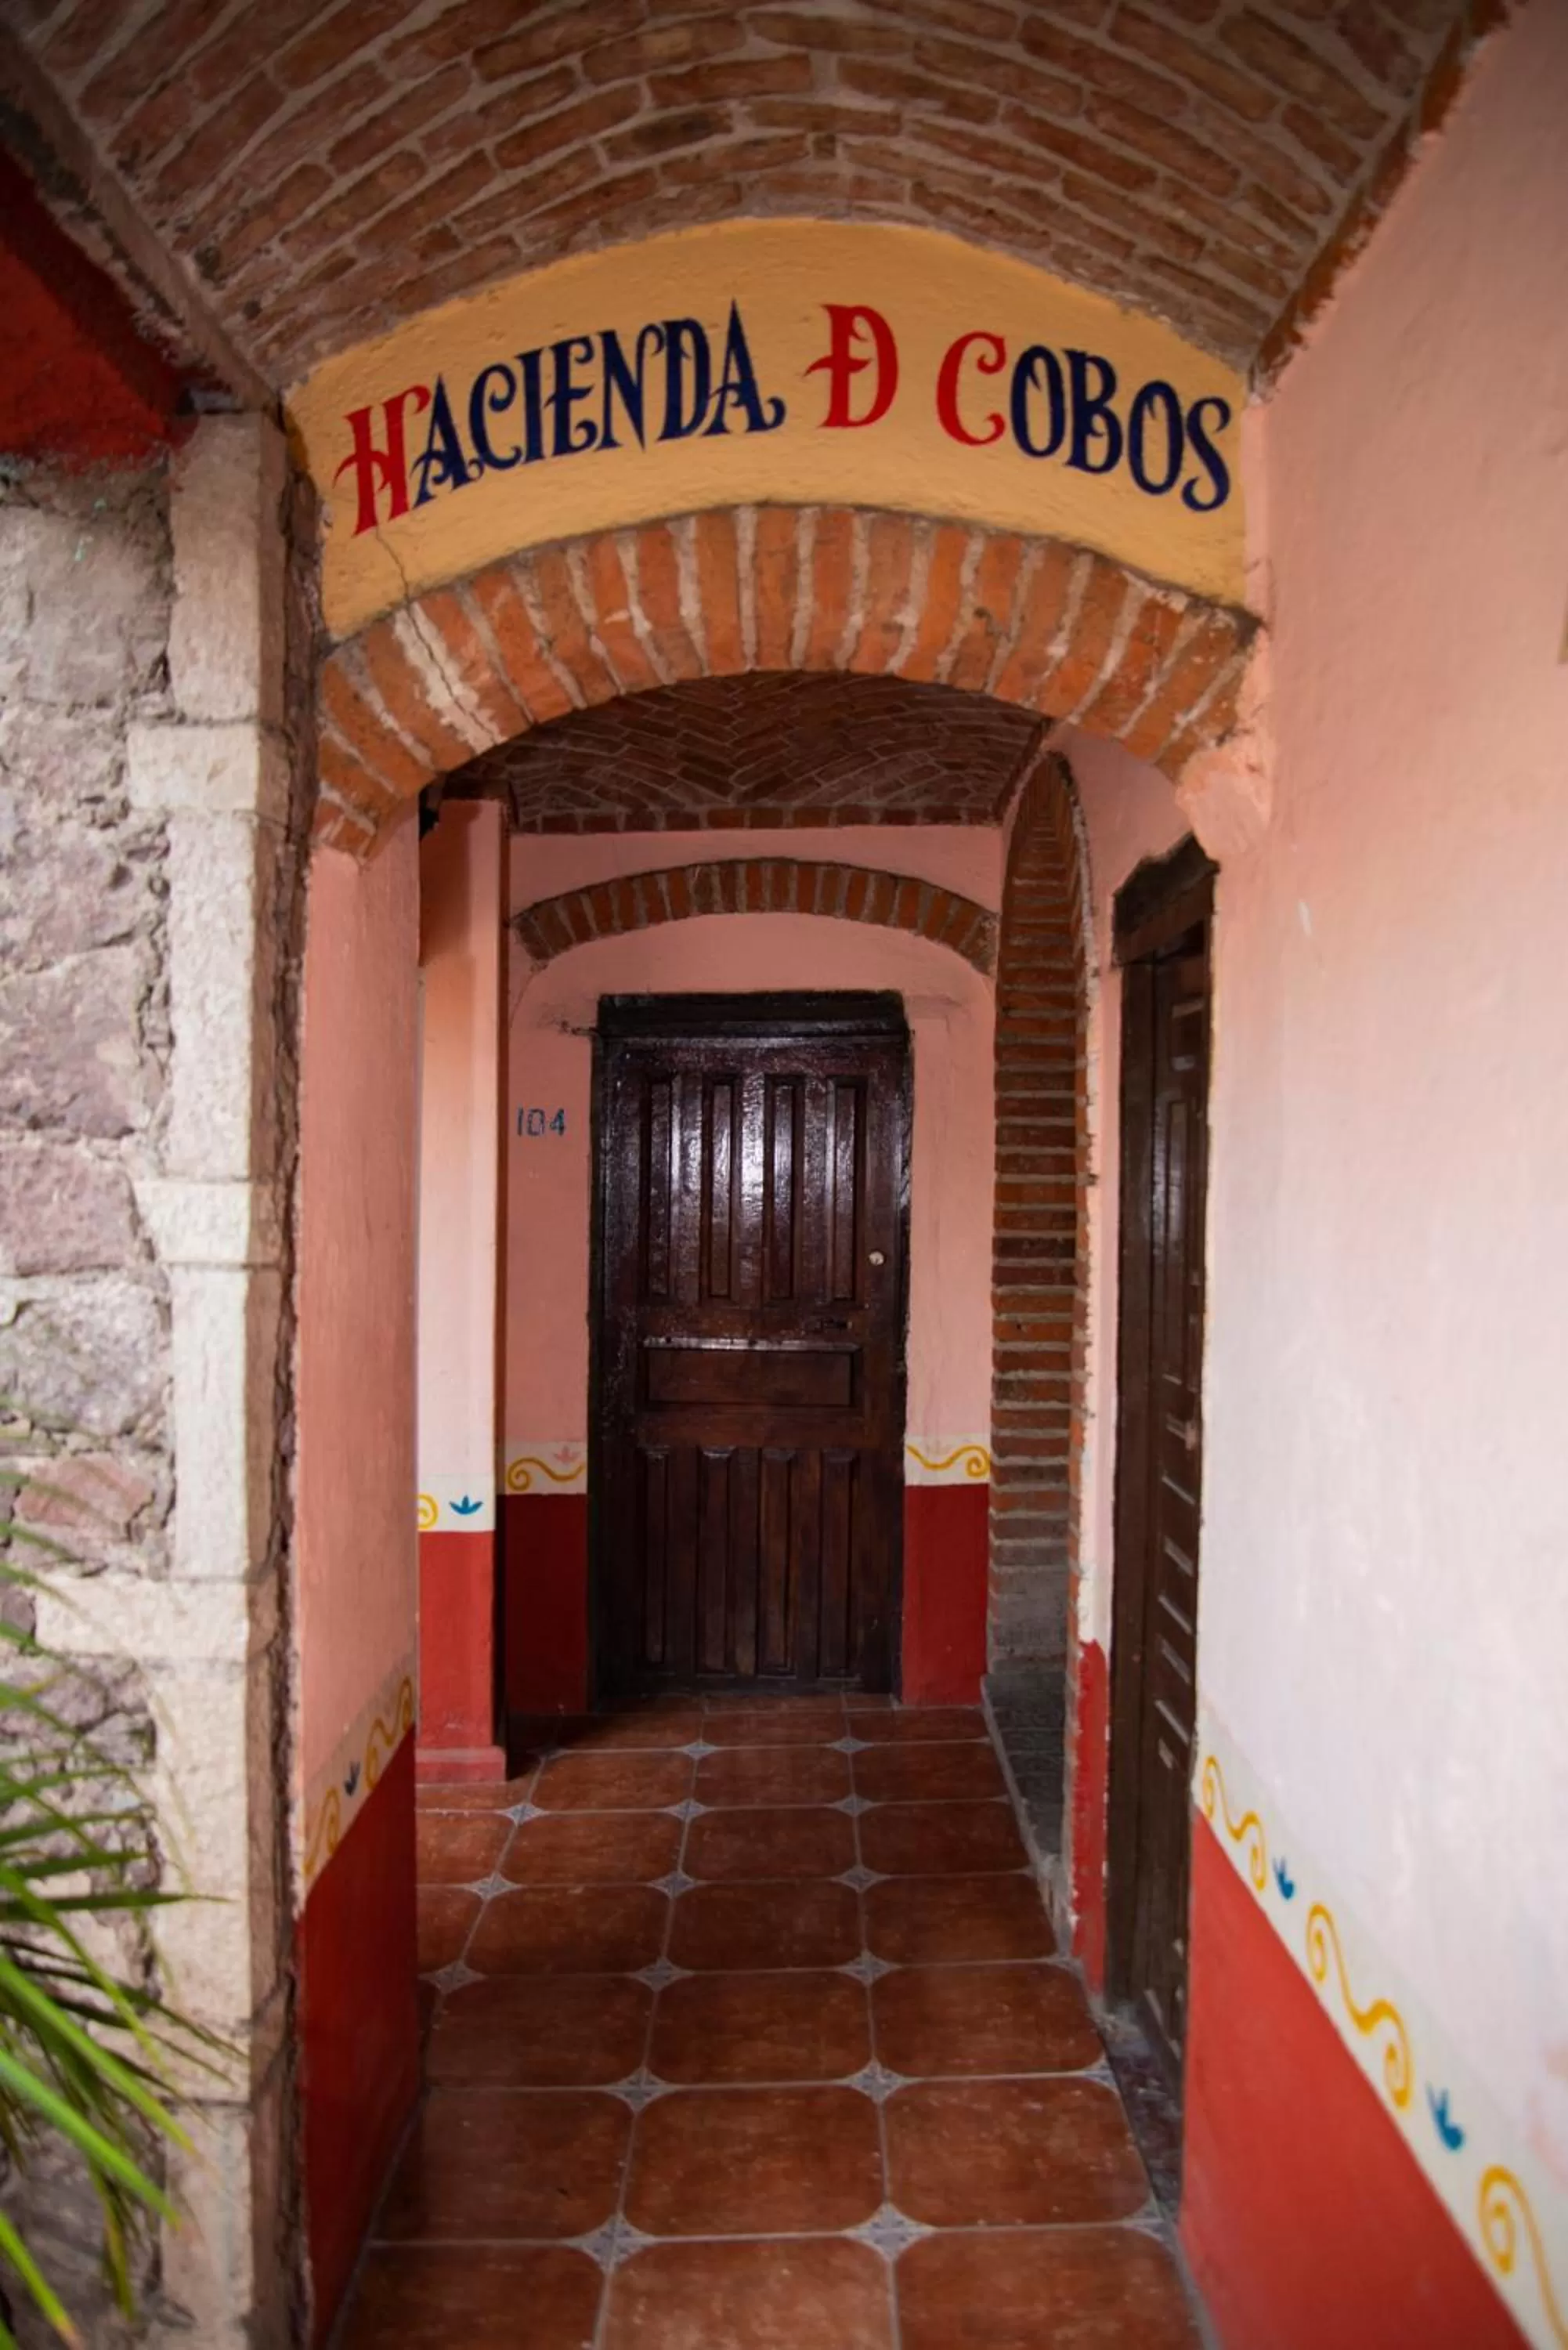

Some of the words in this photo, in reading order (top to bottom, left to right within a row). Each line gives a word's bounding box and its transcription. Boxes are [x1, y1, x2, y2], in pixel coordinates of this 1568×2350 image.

[332, 298, 787, 537] HACIENDA
[936, 331, 1231, 512] COBOS
[517, 1106, 566, 1137] 104
